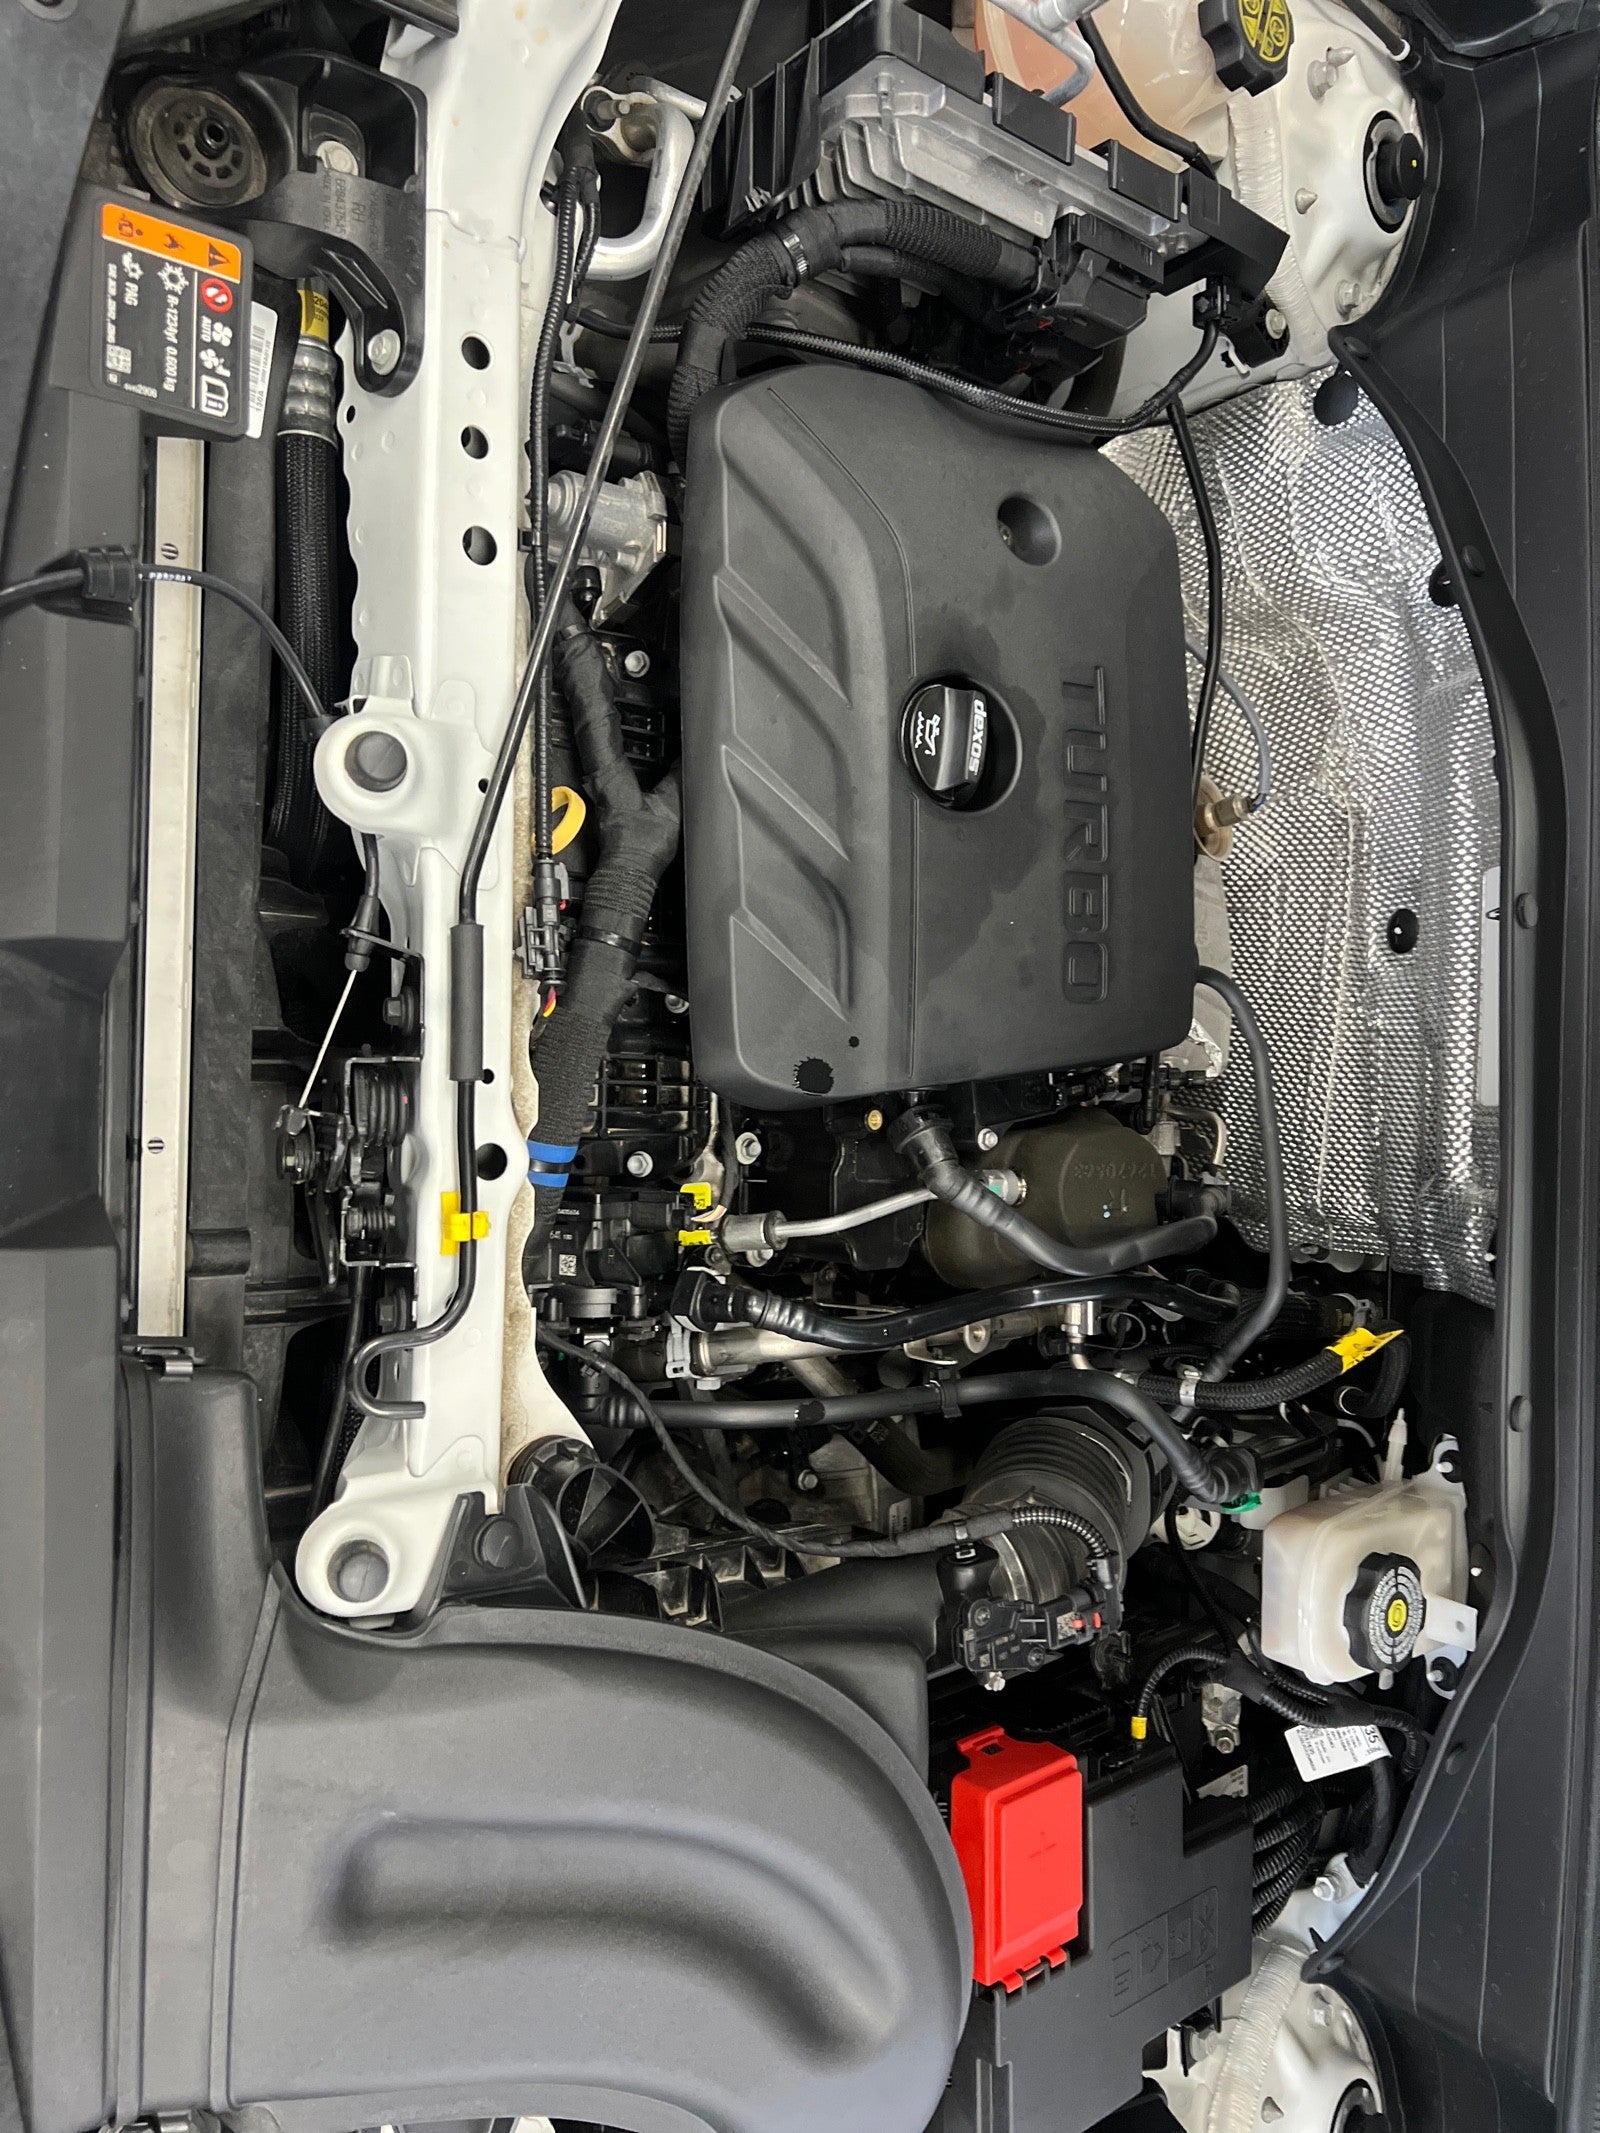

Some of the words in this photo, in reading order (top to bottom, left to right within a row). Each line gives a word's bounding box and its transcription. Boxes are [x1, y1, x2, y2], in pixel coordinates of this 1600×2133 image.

[352, 202, 365, 223] RH
[124, 282, 139, 307] PAG
[163, 294, 179, 344] R-1234yf
[200, 315, 212, 343] AUTO
[165, 347, 178, 377] 0.600
[162, 377, 177, 393] kg
[968, 699, 987, 776] dexos
[1062, 666, 1108, 1003] TURBO
[1365, 1727, 1379, 1744] 35
